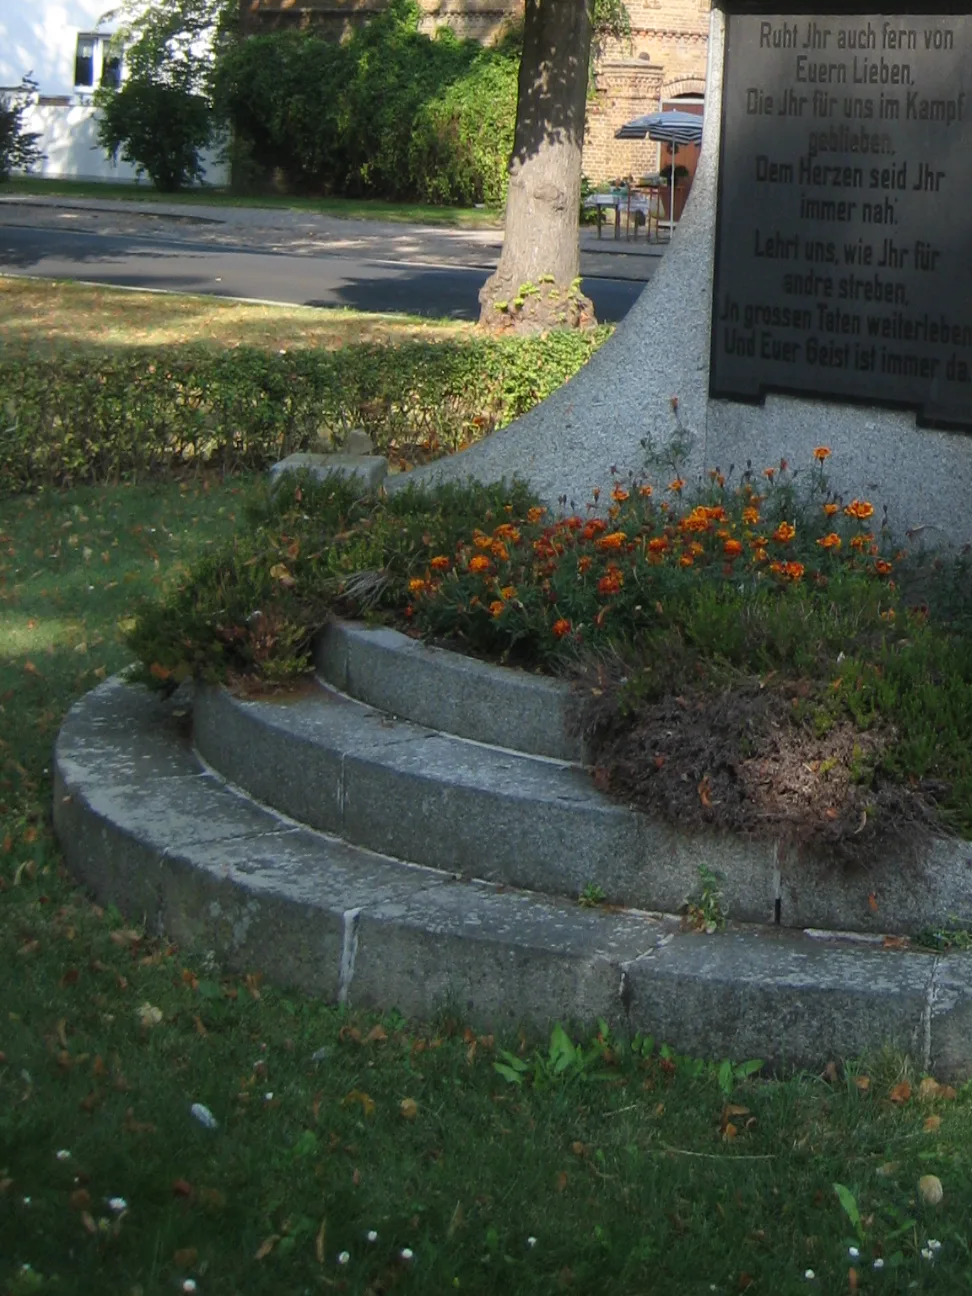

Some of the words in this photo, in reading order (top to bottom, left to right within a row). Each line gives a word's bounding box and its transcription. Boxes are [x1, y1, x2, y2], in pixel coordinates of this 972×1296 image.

[760, 21, 798, 49] Ruht
[838, 22, 876, 50] auch
[882, 22, 917, 50] fern
[924, 29, 954, 50] von
[796, 55, 846, 84] Euern
[853, 56, 915, 86] Lieben,
[747, 88, 773, 116] Die
[812, 90, 838, 118] für
[844, 97, 873, 119] uns
[880, 91, 900, 120] im
[906, 92, 965, 127] Kampf
[755, 156, 794, 185] Dem
[800, 157, 863, 187] Herzen
[870, 162, 906, 189] seid
[800, 194, 857, 222] immer
[754, 230, 800, 260] Lehrt
[805, 241, 838, 267] uns,
[844, 239, 872, 266] wie
[914, 241, 941, 271] für
[783, 268, 833, 297] andre
[743, 304, 812, 331] grossen
[816, 303, 861, 335] Taten
[867, 310, 972, 347] weiterleben
[724, 329, 756, 357] Und
[761, 332, 801, 362] Euer
[806, 337, 850, 368] Geist
[855, 345, 876, 372] ist
[882, 347, 941, 378] immer
[946, 353, 972, 383] da.
